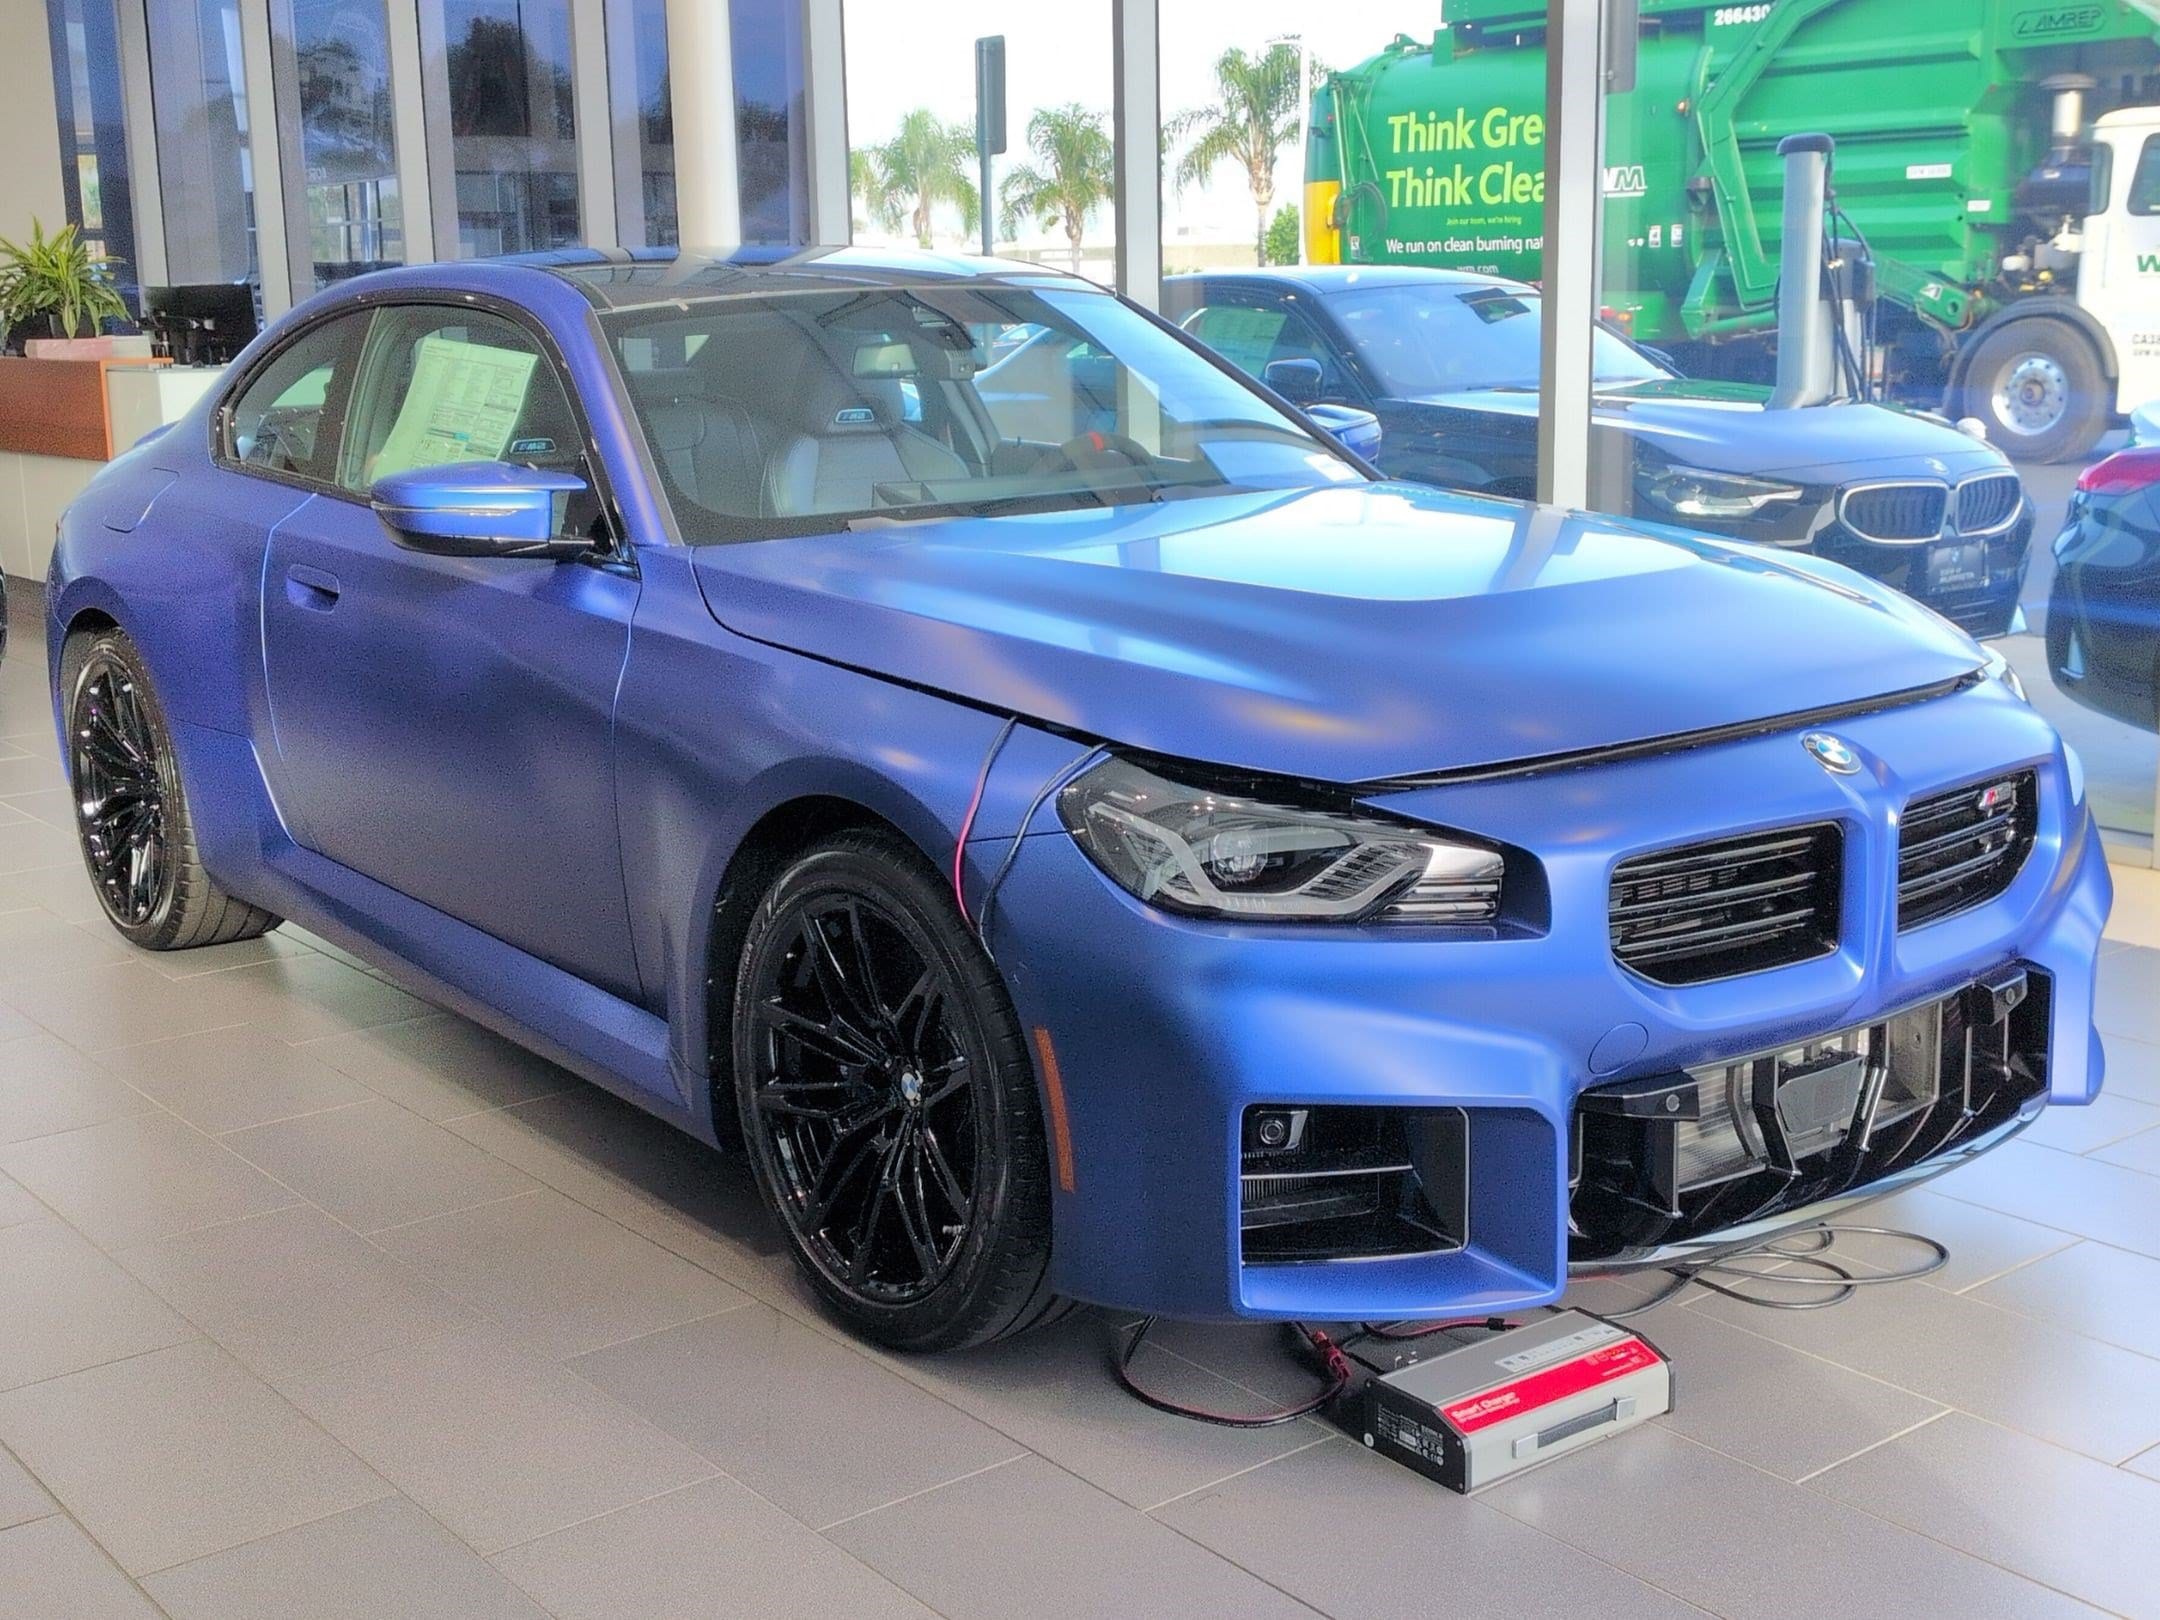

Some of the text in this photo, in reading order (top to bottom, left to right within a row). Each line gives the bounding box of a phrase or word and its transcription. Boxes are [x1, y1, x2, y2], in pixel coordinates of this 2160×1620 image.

[1388, 106, 1545, 153] Think Gre
[1386, 163, 1473, 207] Think
[1386, 238, 1403, 253] We
[1406, 239, 1424, 253] run
[1427, 239, 1442, 252] on
[1444, 236, 1474, 252] clean
[1476, 235, 1522, 254] burning
